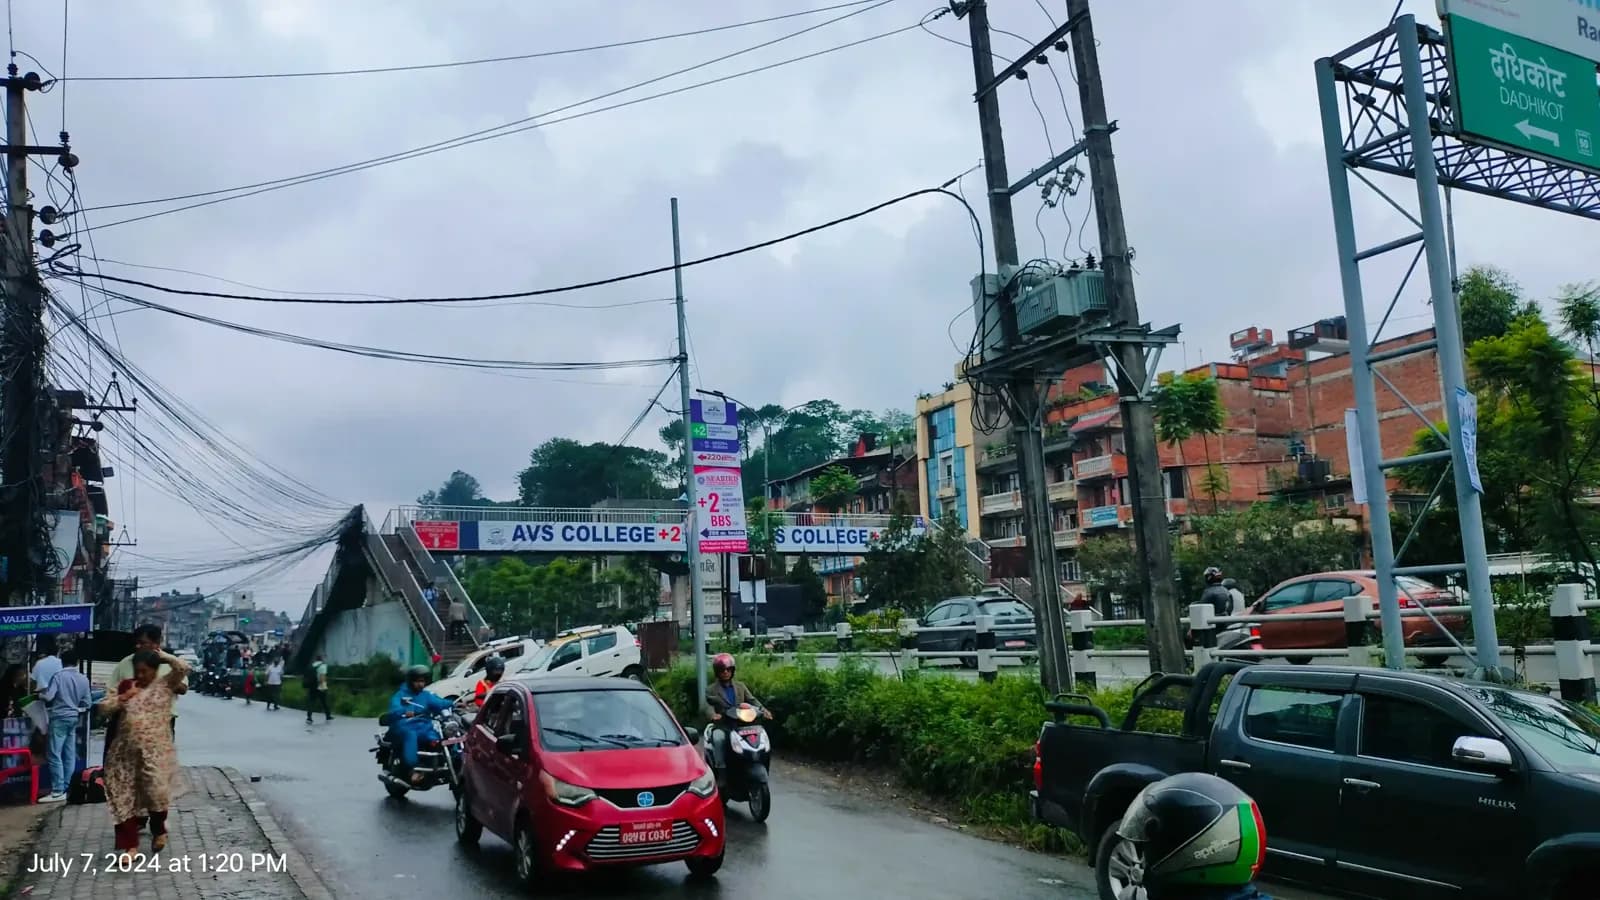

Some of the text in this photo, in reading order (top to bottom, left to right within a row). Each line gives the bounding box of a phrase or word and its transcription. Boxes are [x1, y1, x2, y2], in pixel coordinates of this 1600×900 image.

[1489, 42, 1568, 98] दधिकोट
[1499, 86, 1564, 122] DADHIKOT
[698, 492, 720, 513] +2
[711, 515, 732, 527] BBS
[512, 524, 554, 542] AVS
[561, 525, 656, 543] COLLEGE
[658, 526, 681, 542] +2
[791, 528, 868, 544] COLLEGE
[3, 615, 39, 623] VALLEY
[1477, 796, 1517, 810] HILUX
